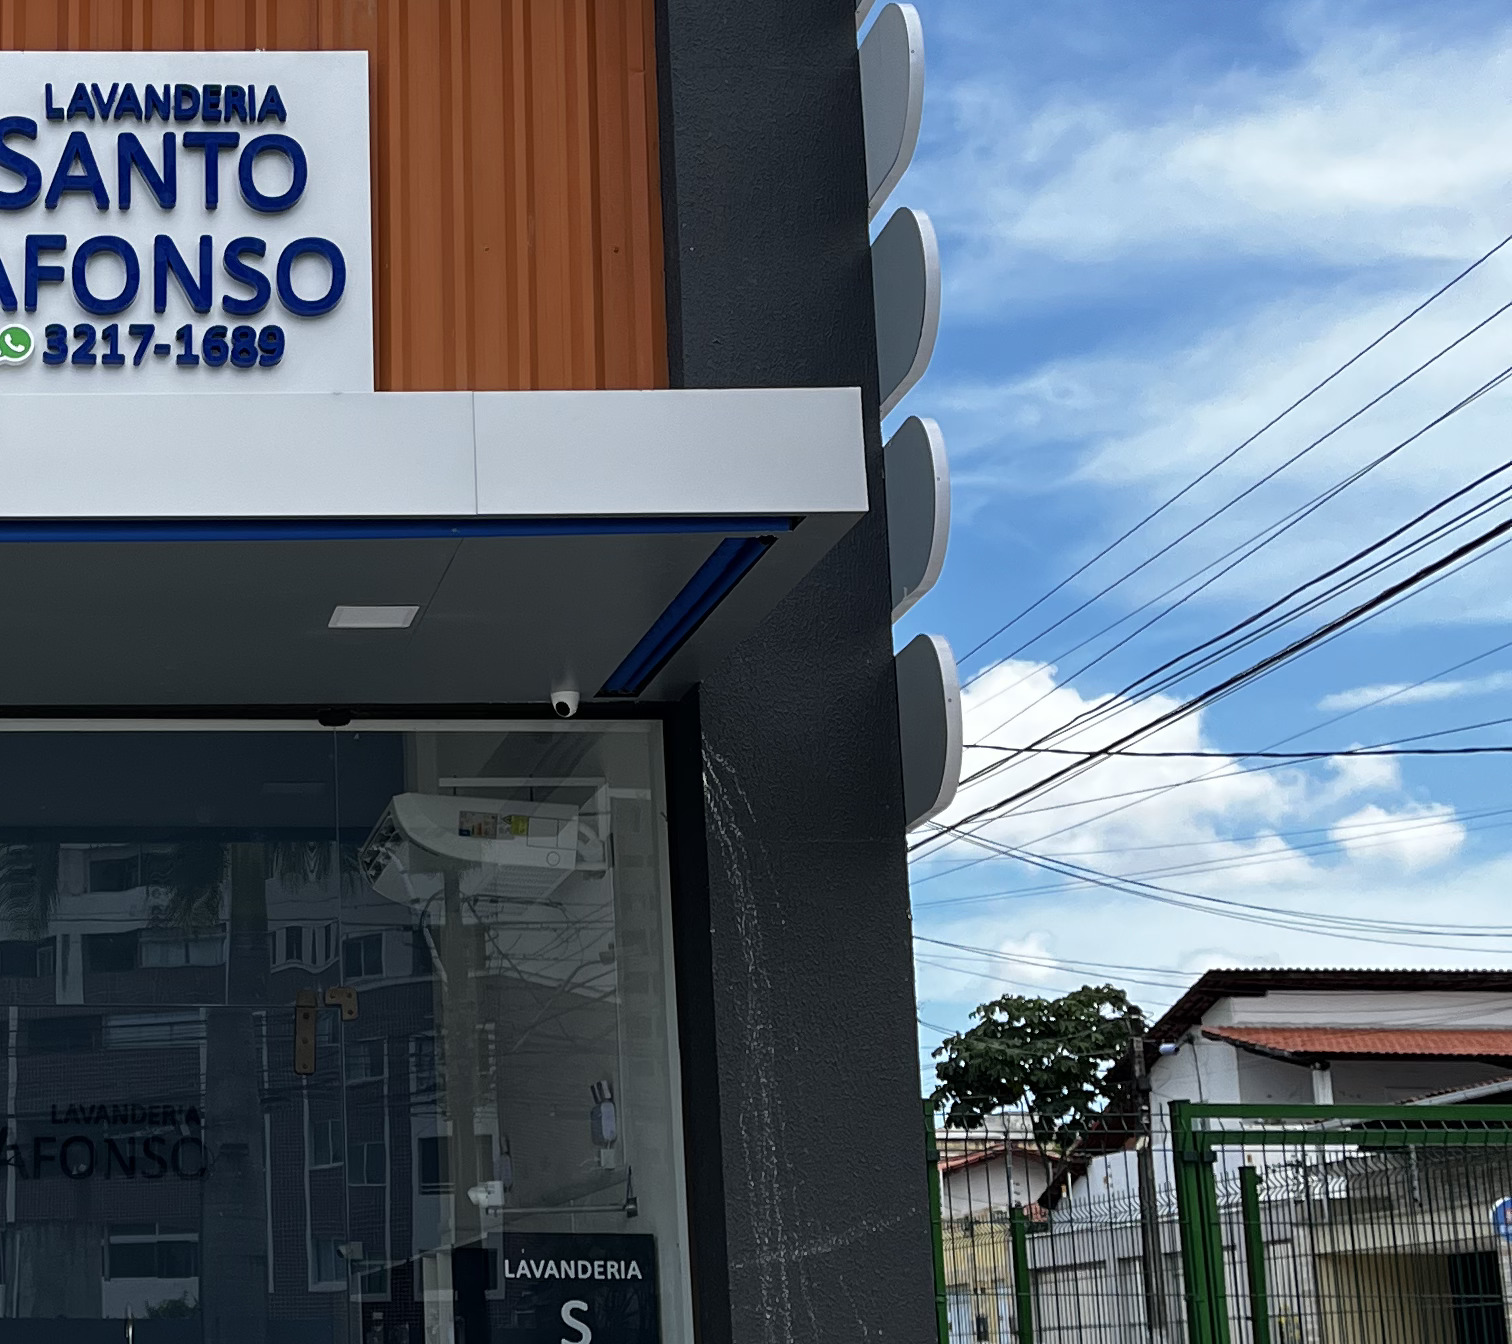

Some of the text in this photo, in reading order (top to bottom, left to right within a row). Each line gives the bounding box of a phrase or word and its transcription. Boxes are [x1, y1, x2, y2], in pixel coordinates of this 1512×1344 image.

[45, 83, 287, 123] LAVANDERIA
[42, 323, 286, 368] 3217-1689
[504, 1259, 643, 1281] LAVANDERIA
